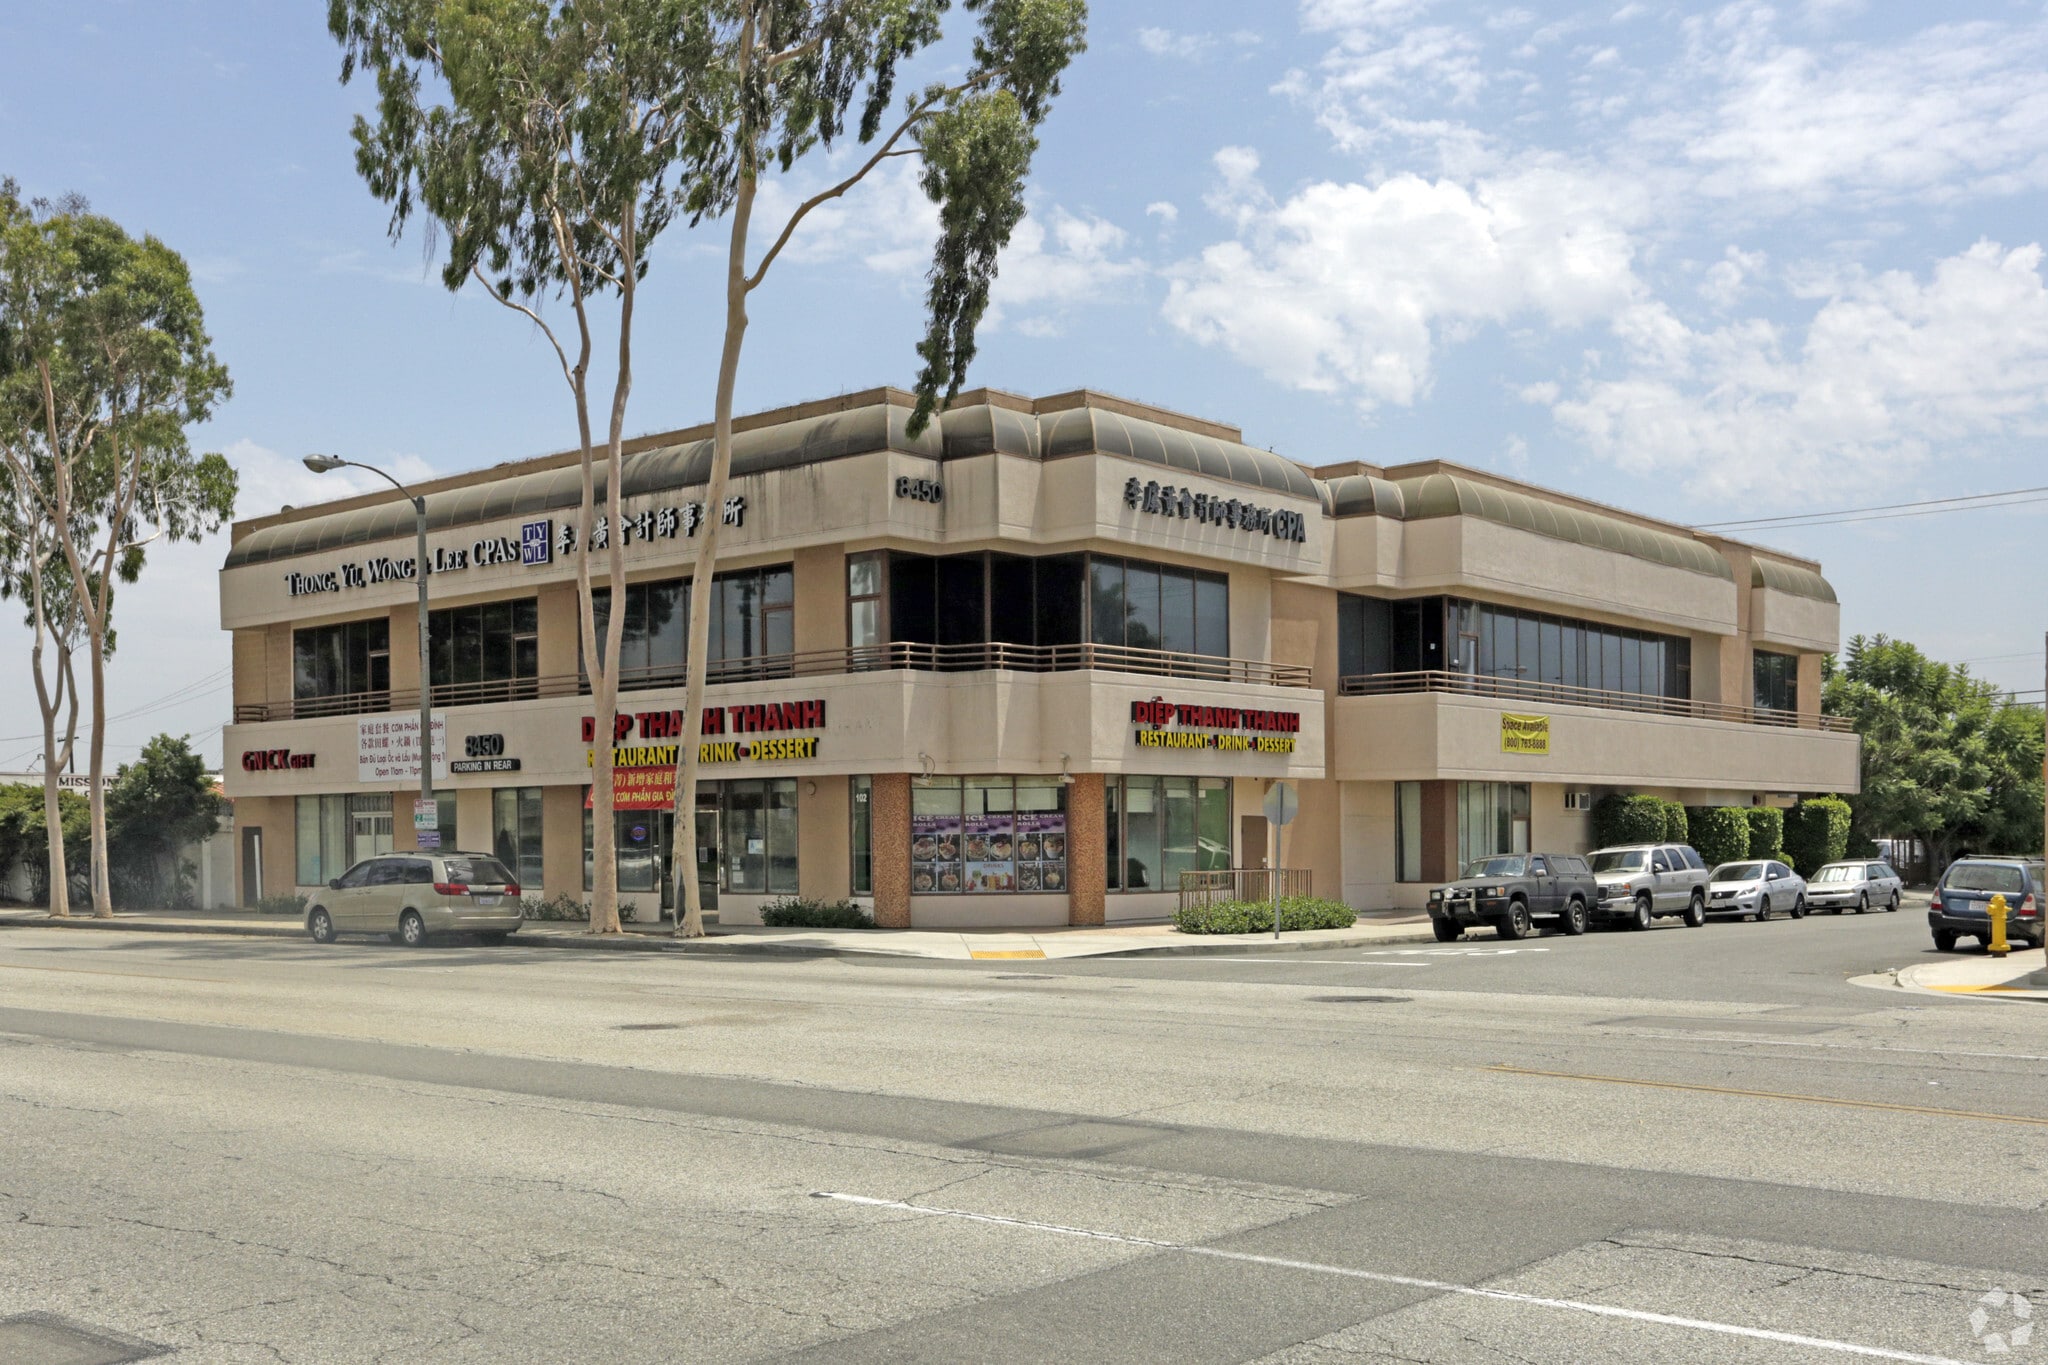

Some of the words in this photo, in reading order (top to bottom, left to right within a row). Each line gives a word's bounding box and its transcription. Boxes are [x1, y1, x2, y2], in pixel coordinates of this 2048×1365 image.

[896, 476, 943, 503] 8450
[1274, 508, 1305, 542] CPA
[634, 705, 725, 738] THAH
[727, 699, 825, 733] THANH
[1178, 704, 1240, 729] THANH
[1243, 709, 1300, 733] THANH
[465, 734, 504, 757] 8450
[587, 745, 679, 768] RTAURANT
[698, 742, 740, 763] RINK
[750, 737, 819, 761] DESSERT
[1138, 730, 1210, 750] RESTAURANT
[1216, 735, 1250, 751] DRINK
[1256, 736, 1297, 753] DESSERT
[453, 761, 482, 772] PARKING
[483, 761, 492, 771] IN
[493, 760, 512, 770] REAR
